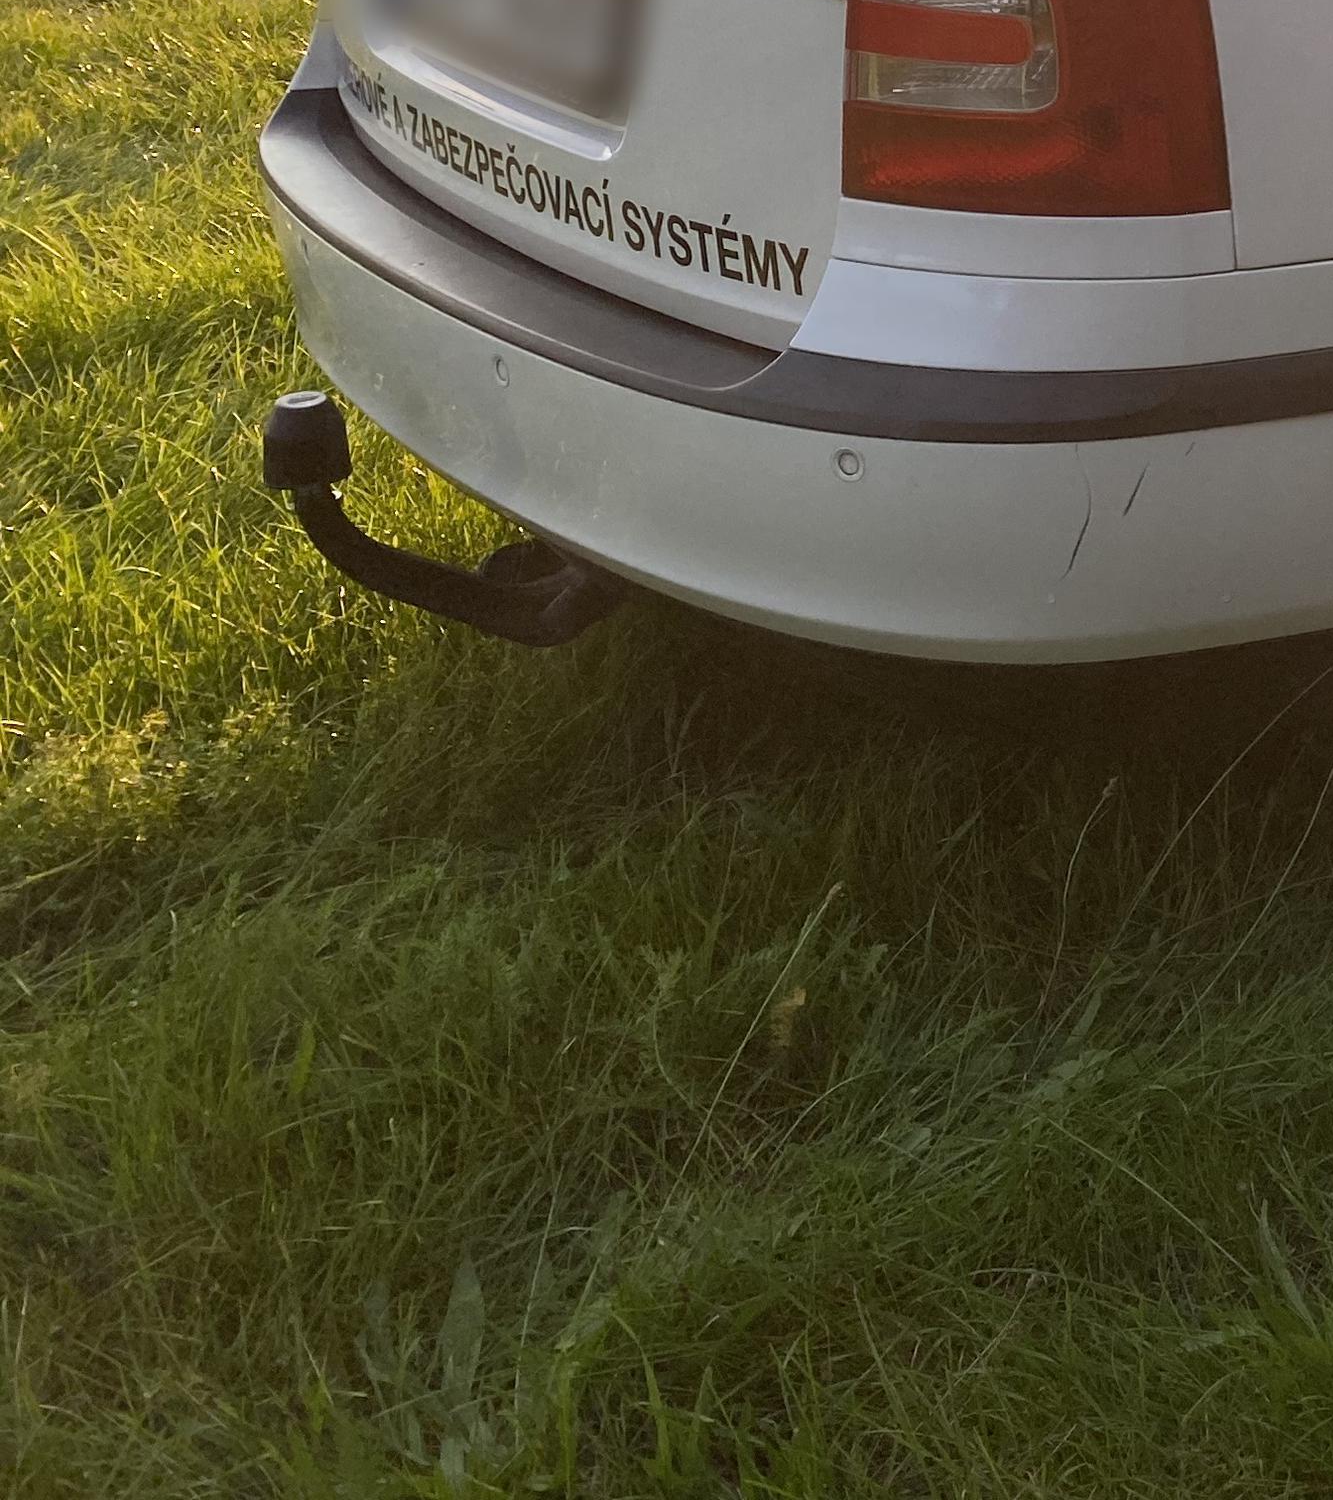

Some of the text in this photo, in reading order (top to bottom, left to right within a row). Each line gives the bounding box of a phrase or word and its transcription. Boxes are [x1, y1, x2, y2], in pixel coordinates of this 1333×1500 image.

[393, 95, 409, 141] A
[407, 104, 613, 240] ZABEZPEČOVACÍ
[622, 198, 810, 296] SYSTÉMY
